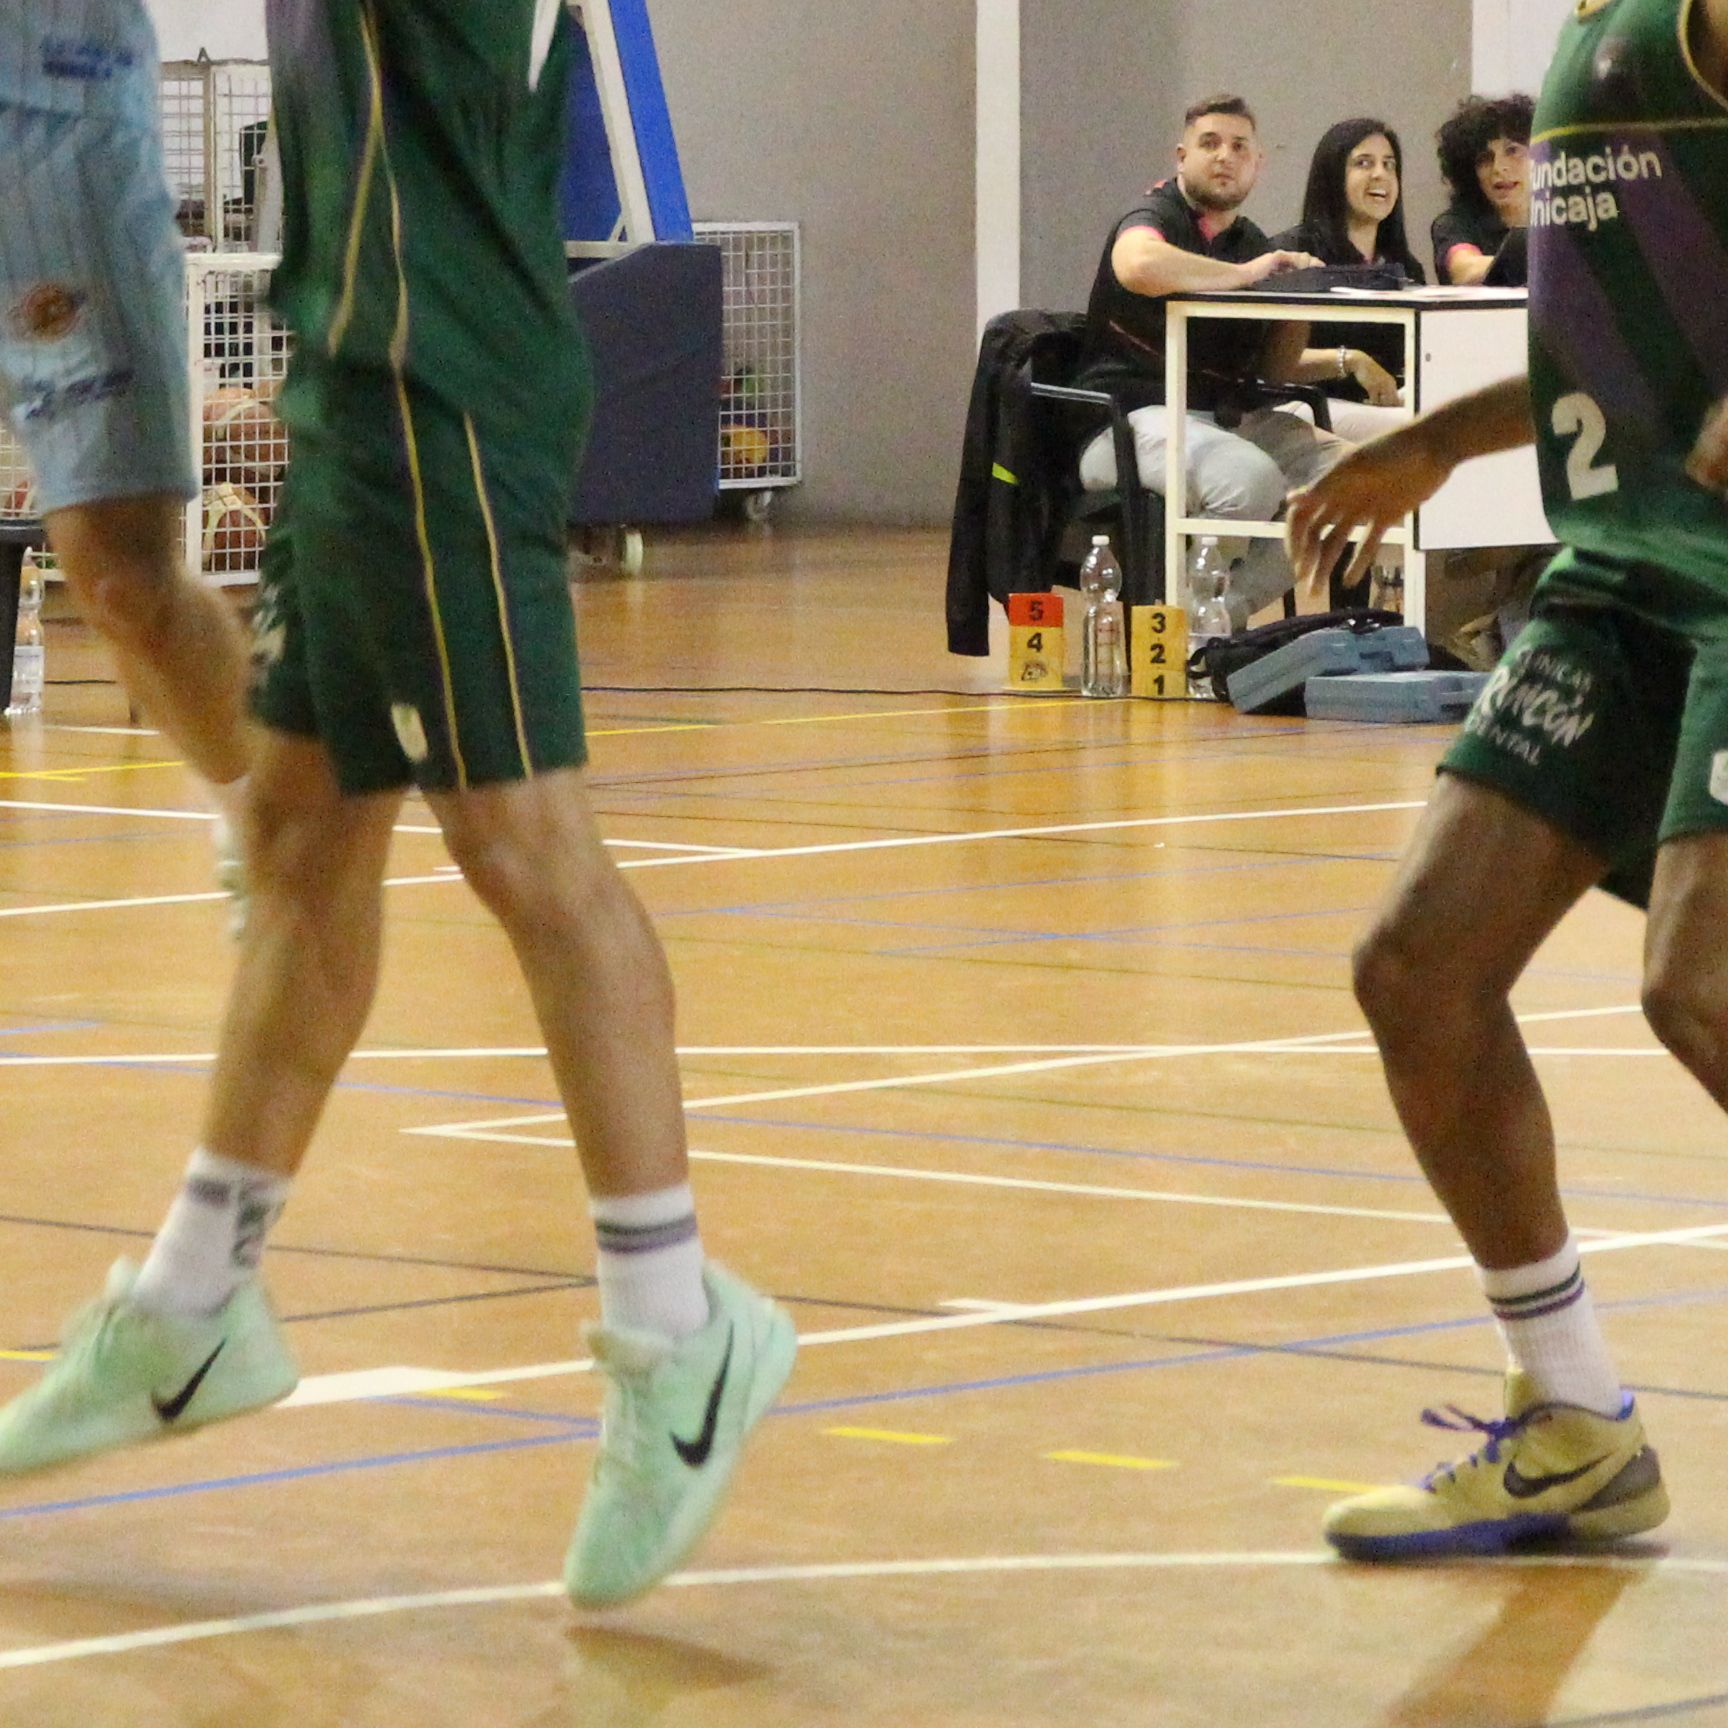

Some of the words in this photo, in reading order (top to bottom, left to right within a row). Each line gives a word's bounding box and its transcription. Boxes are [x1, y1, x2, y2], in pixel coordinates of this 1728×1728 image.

[1529, 144, 1663, 192] undación
[1551, 391, 1619, 502] 2
[1029, 600, 1045, 622] 5
[1150, 611, 1167, 634] 3
[1026, 632, 1044, 653] 4
[1149, 642, 1167, 664] 2
[1153, 674, 1166, 696] 1
